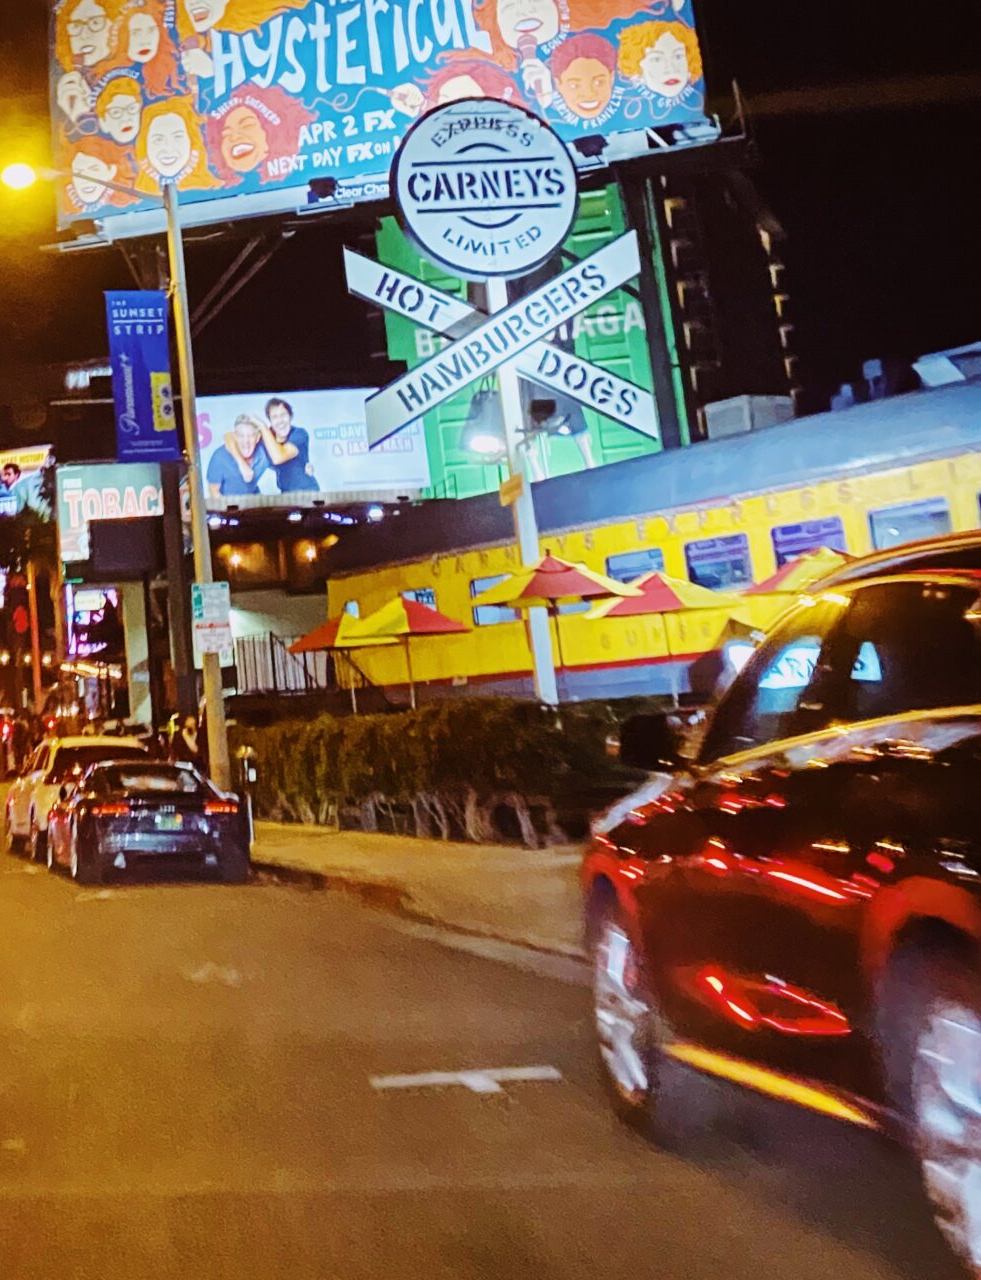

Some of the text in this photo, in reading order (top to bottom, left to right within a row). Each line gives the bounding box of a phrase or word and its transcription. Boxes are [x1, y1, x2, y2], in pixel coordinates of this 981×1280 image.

[582, 86, 626, 130] FRANKLIN
[298, 109, 397, 148] APR 2 FX
[431, 117, 535, 148] EXPRESS
[267, 154, 308, 176] NEXT
[312, 146, 343, 168] DAY
[347, 142, 374, 163] FX
[374, 142, 391, 155] ON
[335, 183, 390, 199] Clear Cha
[407, 168, 566, 202] CARNEYS
[442, 226, 542, 256] LIMITED
[112, 308, 164, 318] SUNSET
[375, 272, 451, 322] HOT
[114, 324, 165, 335] STRIP
[396, 265, 607, 412] HAMBURGERS
[536, 350, 638, 417] DOGS
[339, 423, 366, 439] DAVI
[63, 485, 191, 528] TOBAC
[432, 531, 595, 576] CARNYS
